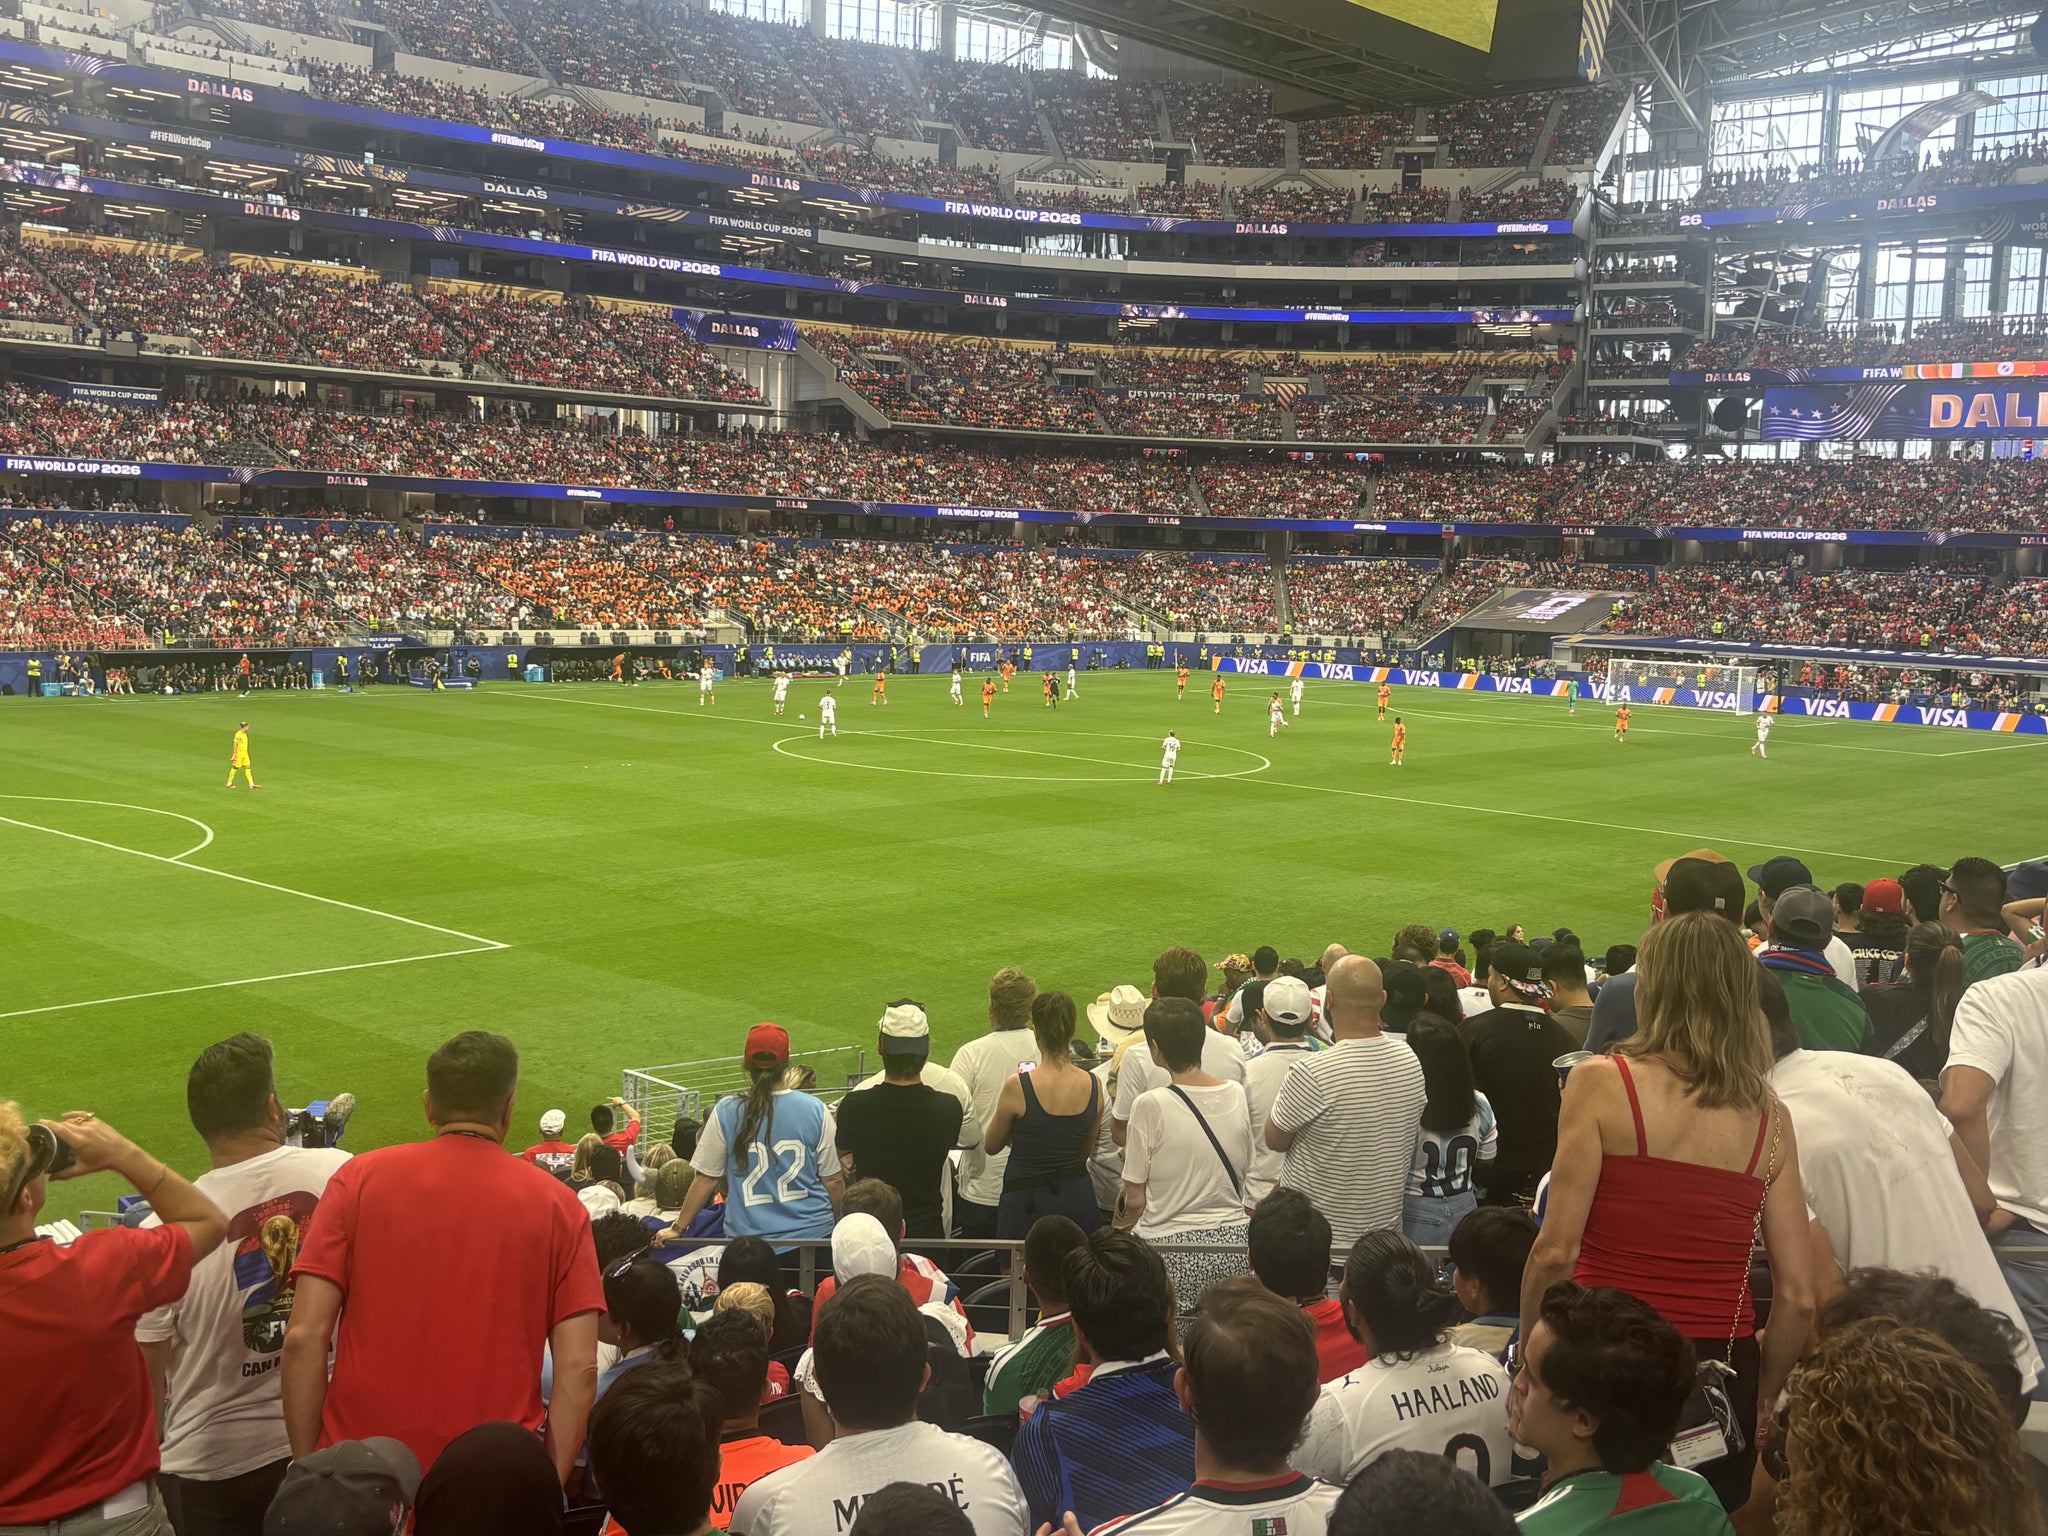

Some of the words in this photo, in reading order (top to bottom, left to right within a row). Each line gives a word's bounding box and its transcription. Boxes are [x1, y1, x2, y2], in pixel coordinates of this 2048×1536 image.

[188, 79, 253, 102] DALLAS
[150, 130, 212, 150] #FIFAWorldCup
[752, 174, 800, 191] DALLAS
[484, 183, 548, 200] DALLAS
[245, 202, 300, 221] DALLAS
[1877, 195, 1937, 211] DALLAS
[945, 201, 971, 215] FIFA
[971, 204, 1013, 219] WORLD
[1014, 209, 1038, 221] CUP
[1039, 211, 1082, 225] 2026
[709, 215, 729, 226] FIFA
[729, 218, 762, 231] WORLD
[763, 223, 781, 233] CUP
[781, 226, 812, 238] 2026
[1236, 223, 1288, 235] DALLAS
[592, 249, 617, 264] FIFA
[617, 253, 658, 268] WORLD
[659, 258, 681, 271] CUP
[681, 261, 721, 276] 2026
[964, 294, 1007, 307] DALLAS
[711, 322, 759, 337] DALLAS
[1704, 372, 1751, 383] DALLAS
[1863, 368, 1885, 379] FIFA
[1885, 368, 1903, 378] W
[73, 388, 90, 397] FIFA
[90, 389, 116, 398] WORLD
[117, 391, 132, 399] CUP
[132, 393, 158, 401] 2026
[6, 458, 33, 470] FIFA
[34, 460, 76, 473] WORLD
[77, 463, 100, 473] CUP
[101, 464, 142, 476] 2026
[326, 475, 368, 487] DALLAS
[776, 500, 808, 509] DALLAS
[937, 508, 953, 516] FIFA
[953, 509, 979, 517] WORLD
[980, 510, 995, 518] CUP
[995, 511, 1019, 519] 2026
[1148, 517, 1180, 526] DALLAS
[1562, 527, 1595, 536] DALLAS
[1743, 530, 1763, 539] FIFA
[1763, 531, 1795, 540] WORLD
[1795, 532, 1815, 540] CUP
[1815, 532, 1848, 541] 2026
[970, 652, 991, 662] FIFA
[1234, 658, 1269, 674] VISA
[1318, 664, 1353, 681] VISA
[1402, 669, 1440, 687] VISA
[1492, 675, 1532, 694] VISA
[1691, 690, 1737, 710] VISA
[1801, 698, 1850, 719] VISA
[1916, 706, 1968, 729] VISA
[742, 1139, 808, 1207] 22
[1421, 1135, 1478, 1198] 10
[242, 1359, 274, 1377] CAN
[1391, 1373, 1499, 1421] HAALAND
